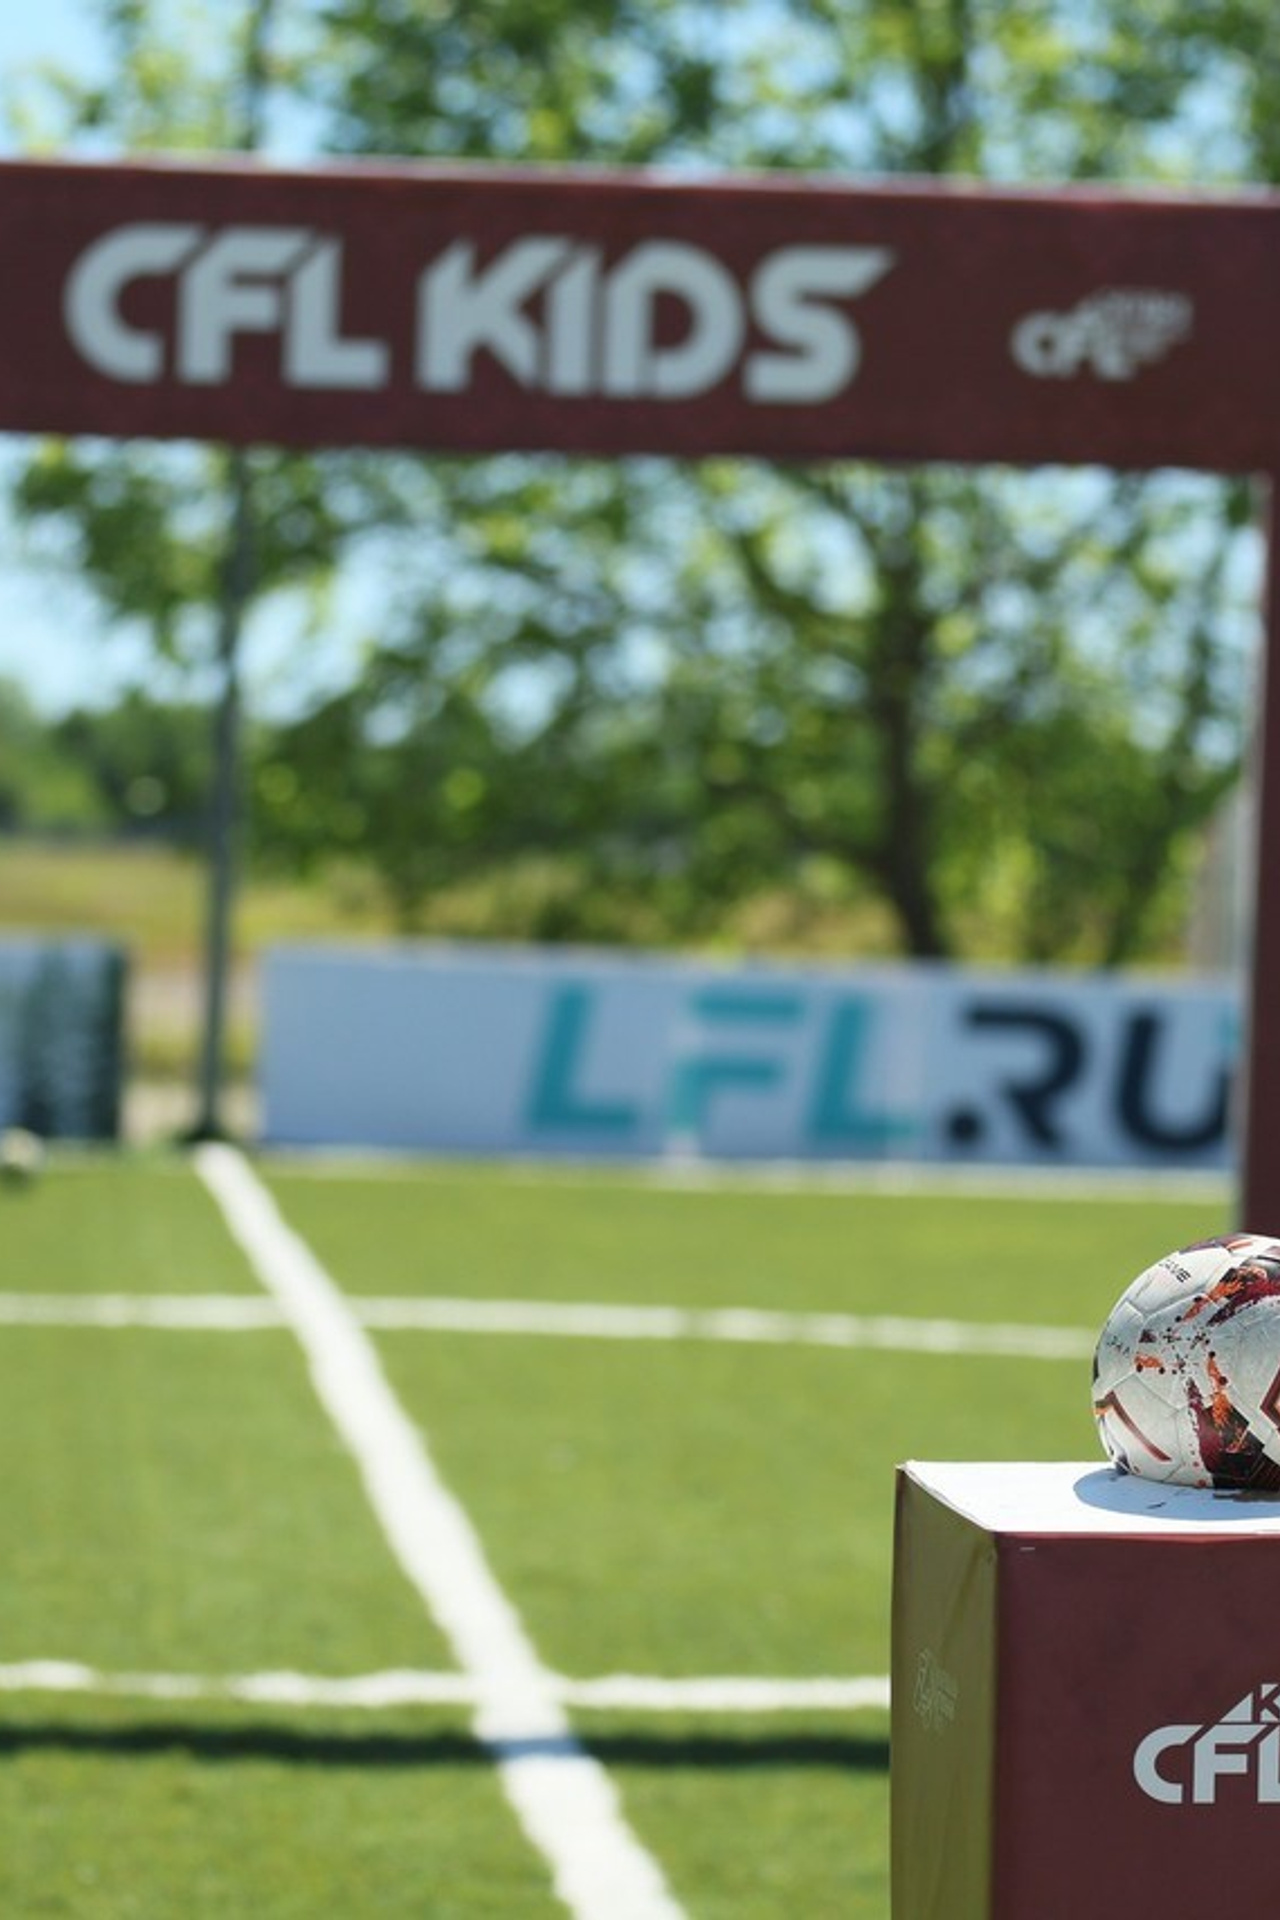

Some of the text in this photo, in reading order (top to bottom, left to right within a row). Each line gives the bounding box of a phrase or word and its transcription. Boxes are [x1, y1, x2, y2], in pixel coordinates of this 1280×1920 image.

[63, 221, 893, 402] CFL KIDS
[523, 982, 1232, 1155] LFL.RU
